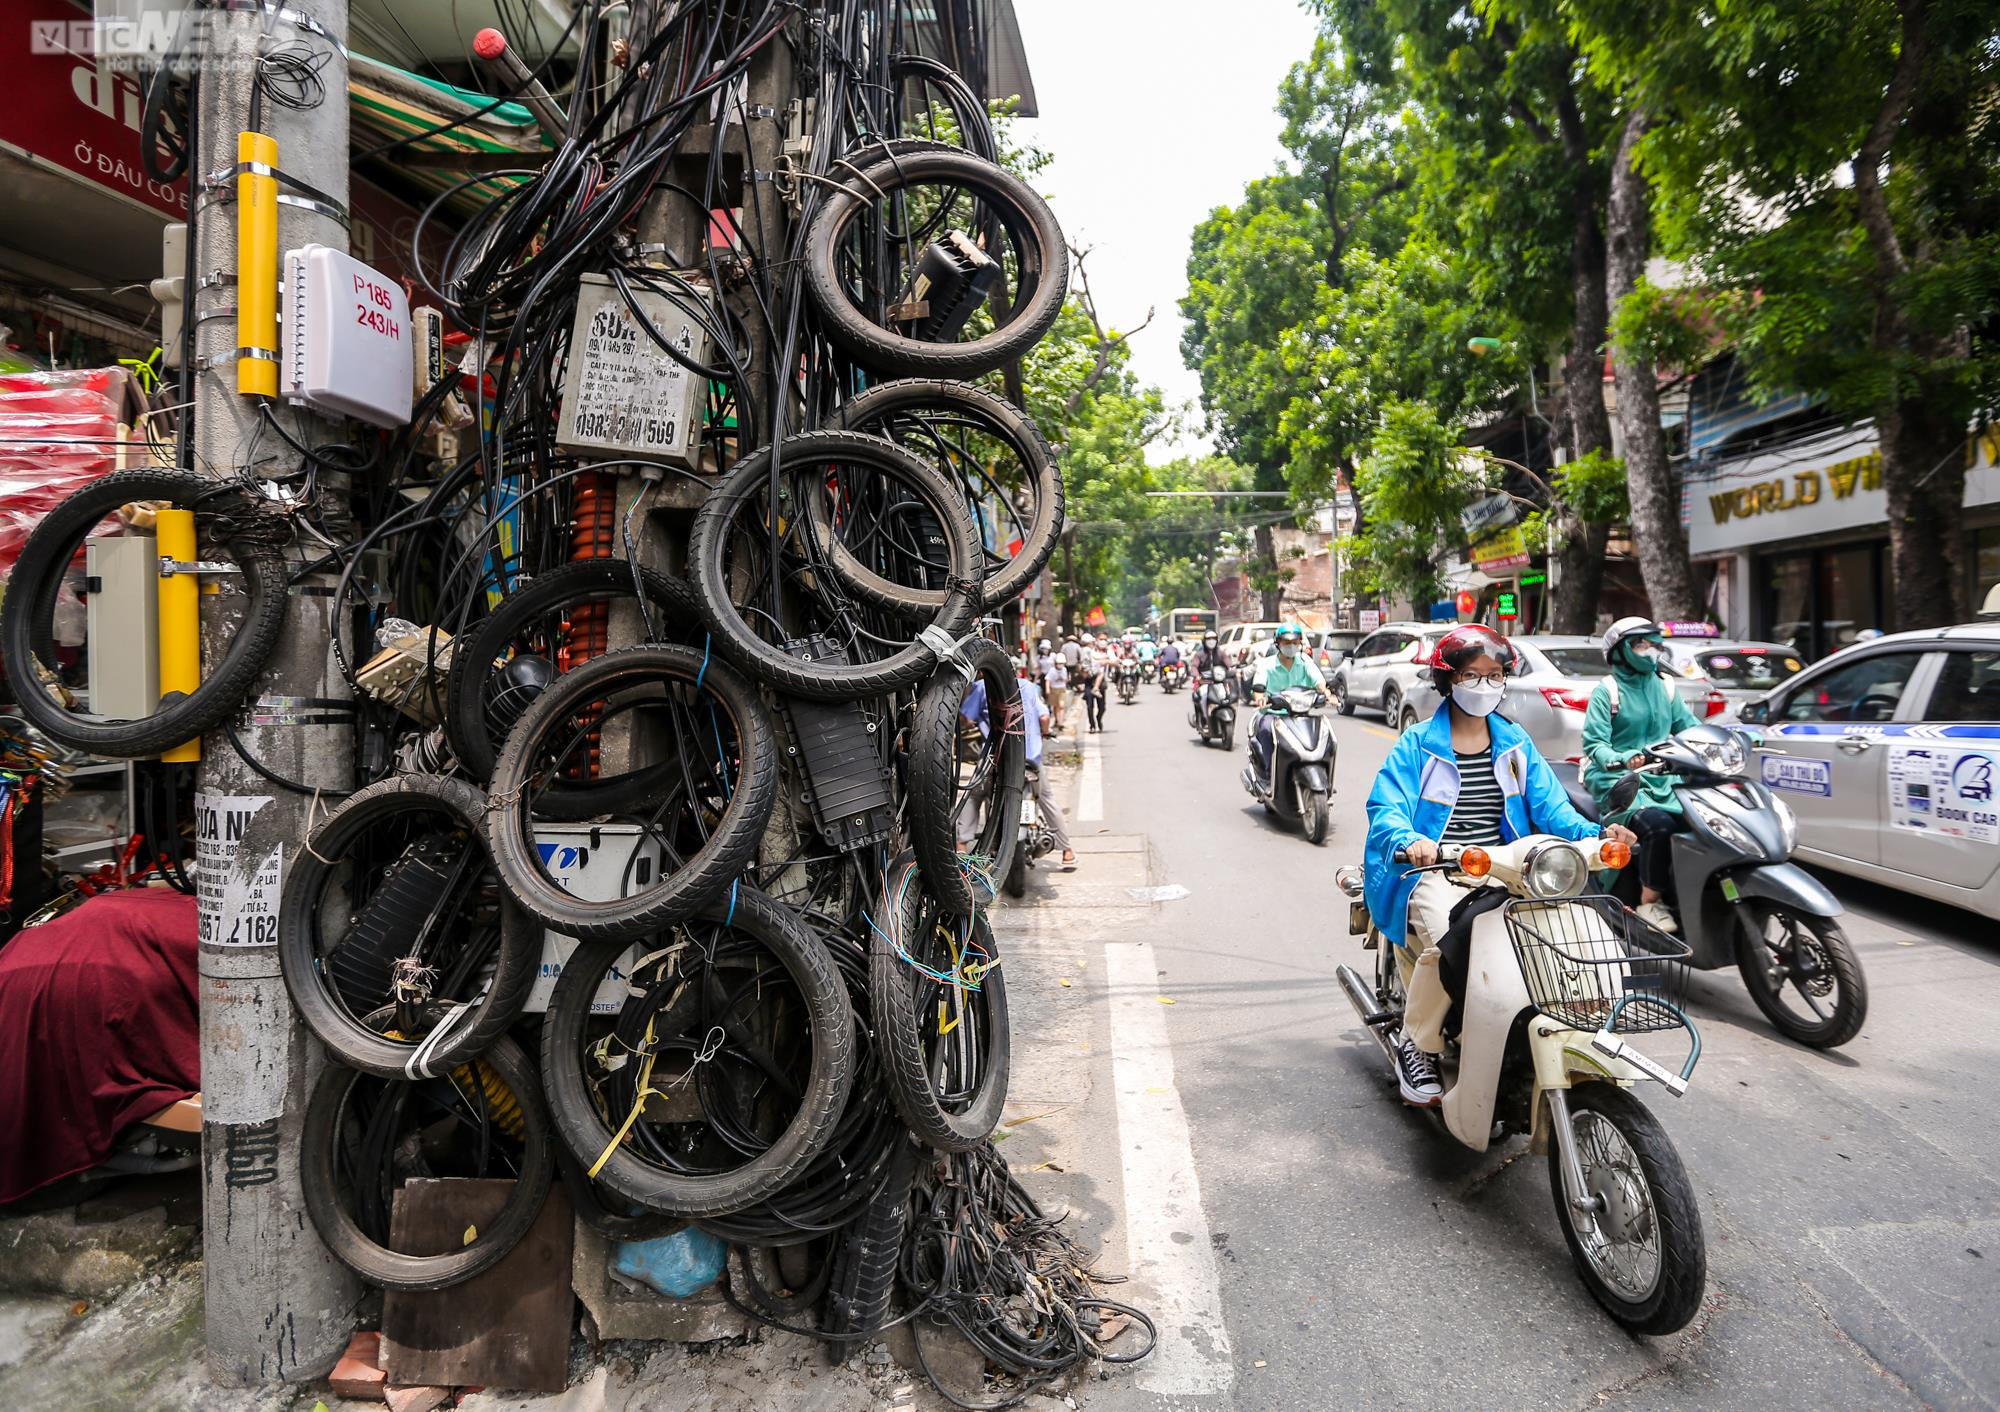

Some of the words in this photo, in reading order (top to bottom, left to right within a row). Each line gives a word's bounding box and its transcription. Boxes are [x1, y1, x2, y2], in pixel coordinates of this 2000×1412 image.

[97, 153, 142, 188] ĐÂU
[357, 304, 400, 341] 243/H
[1709, 470, 1822, 526] WORLD
[1780, 764, 1794, 778] SAO
[1936, 806, 1969, 822] BOOK
[1973, 811, 1998, 827] CAR
[245, 914, 277, 944] 162
